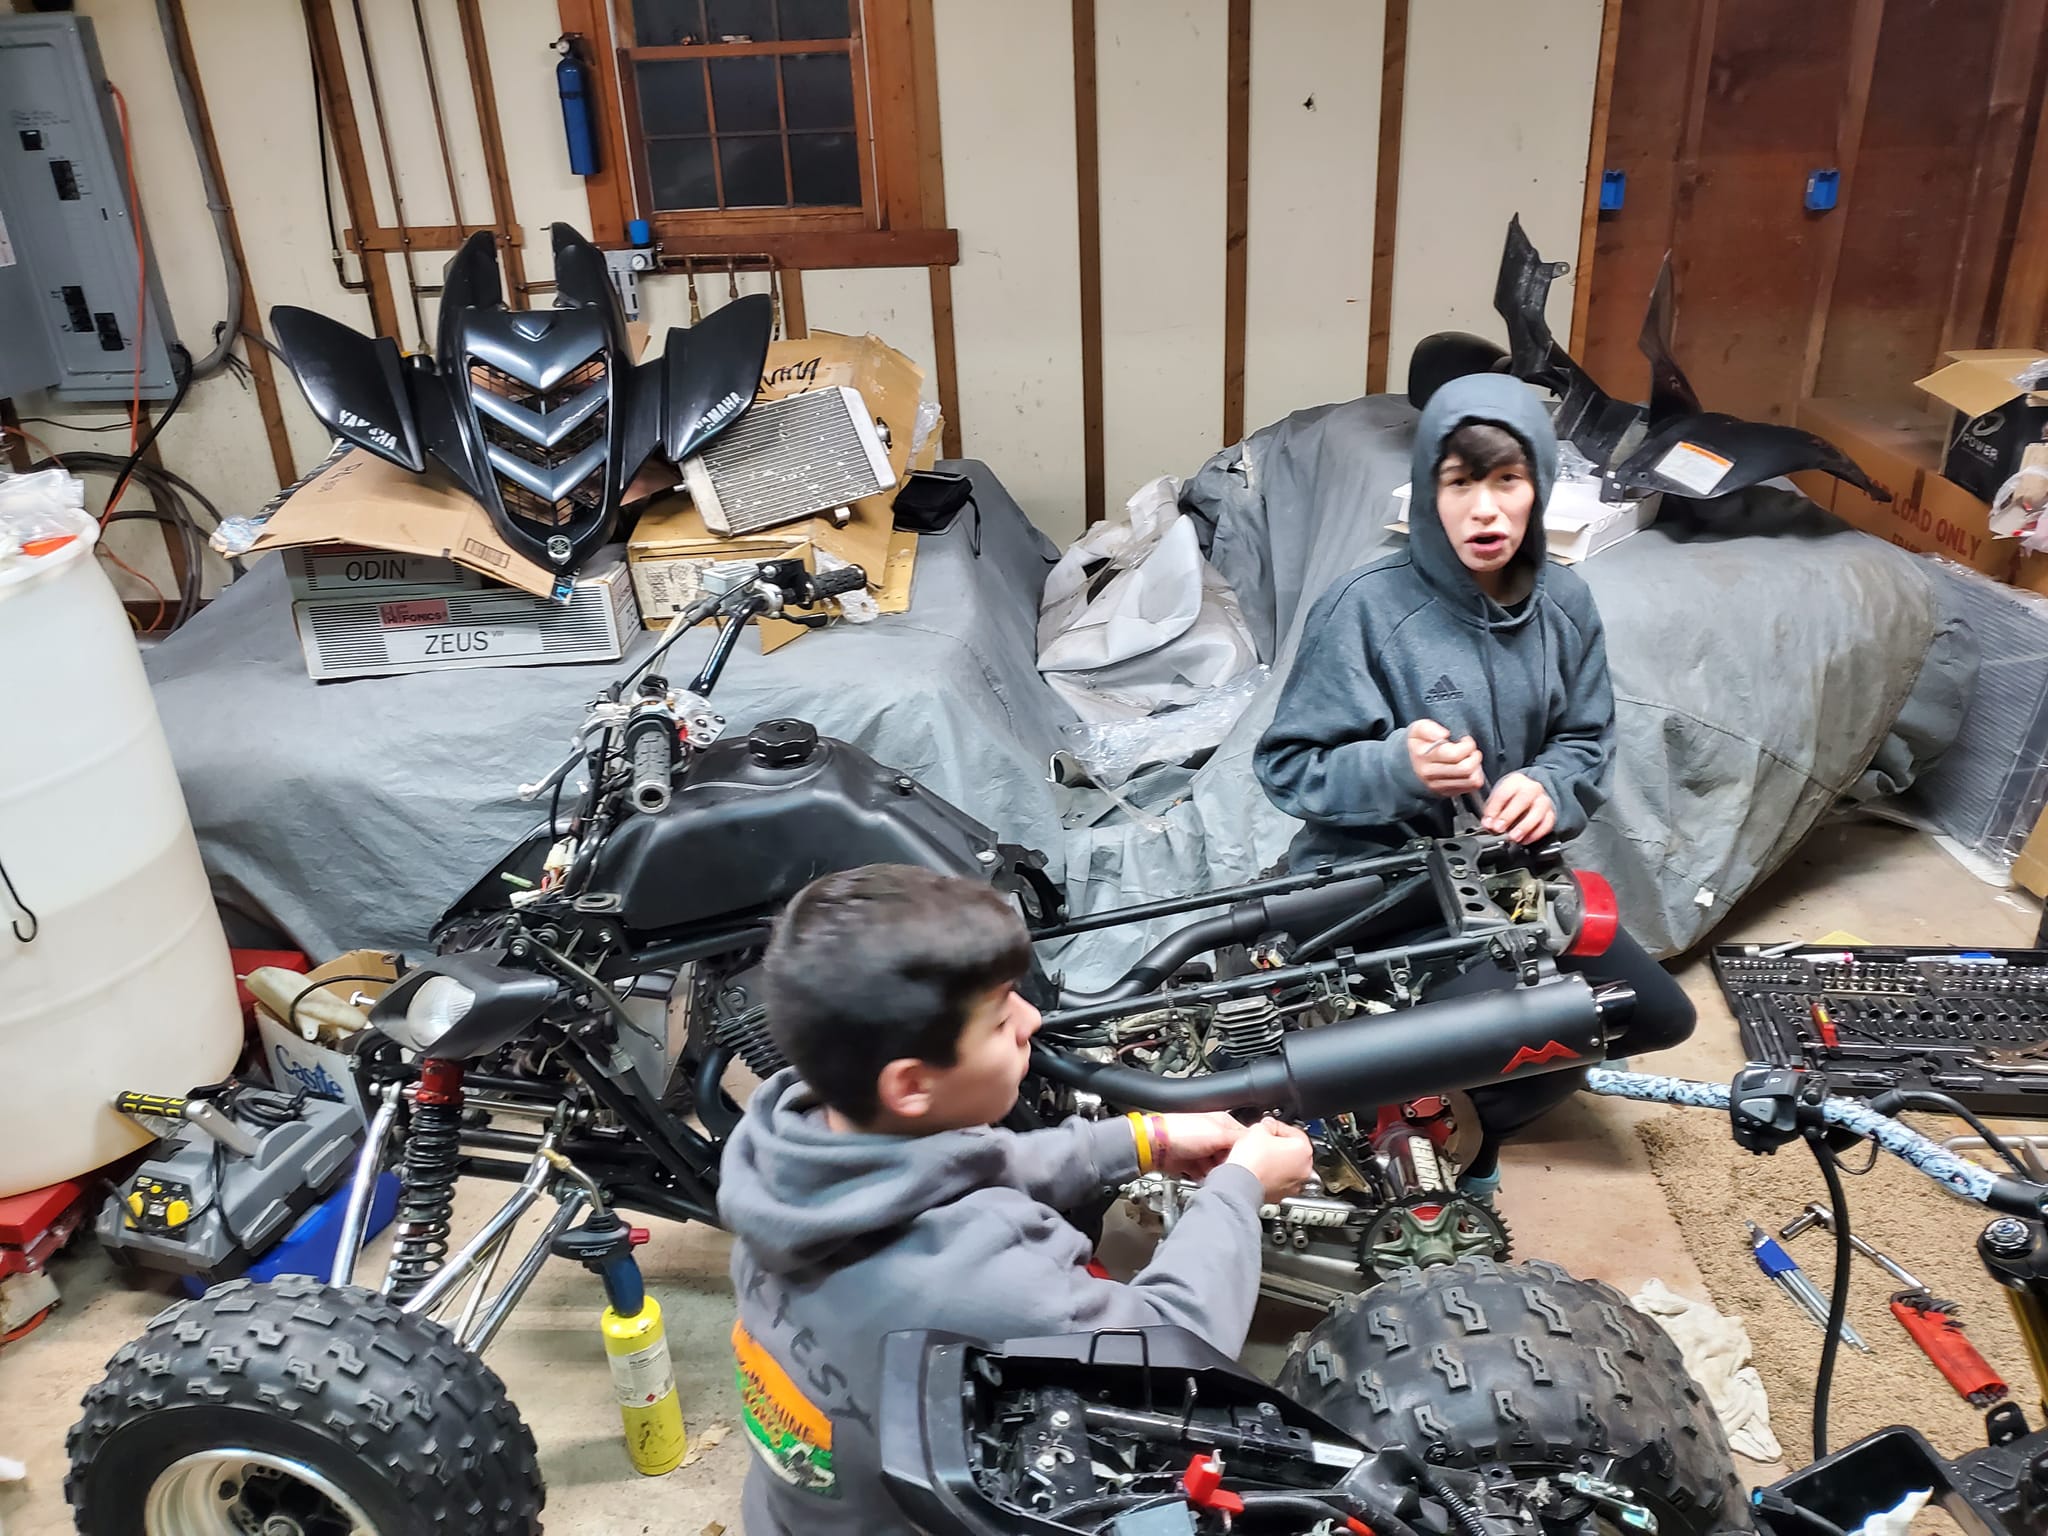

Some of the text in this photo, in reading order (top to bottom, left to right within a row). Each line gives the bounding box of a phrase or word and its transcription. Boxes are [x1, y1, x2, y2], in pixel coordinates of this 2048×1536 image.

[695, 391, 745, 433] YAMAHA
[1962, 432, 1999, 461] POWER
[1892, 491, 1933, 533] LOAD
[1935, 517, 1982, 561] ONLY
[345, 559, 406, 582] ODIN
[424, 630, 489, 655] ZEUS
[1424, 690, 1464, 703] adidas
[1286, 1205, 1350, 1227] ARM
